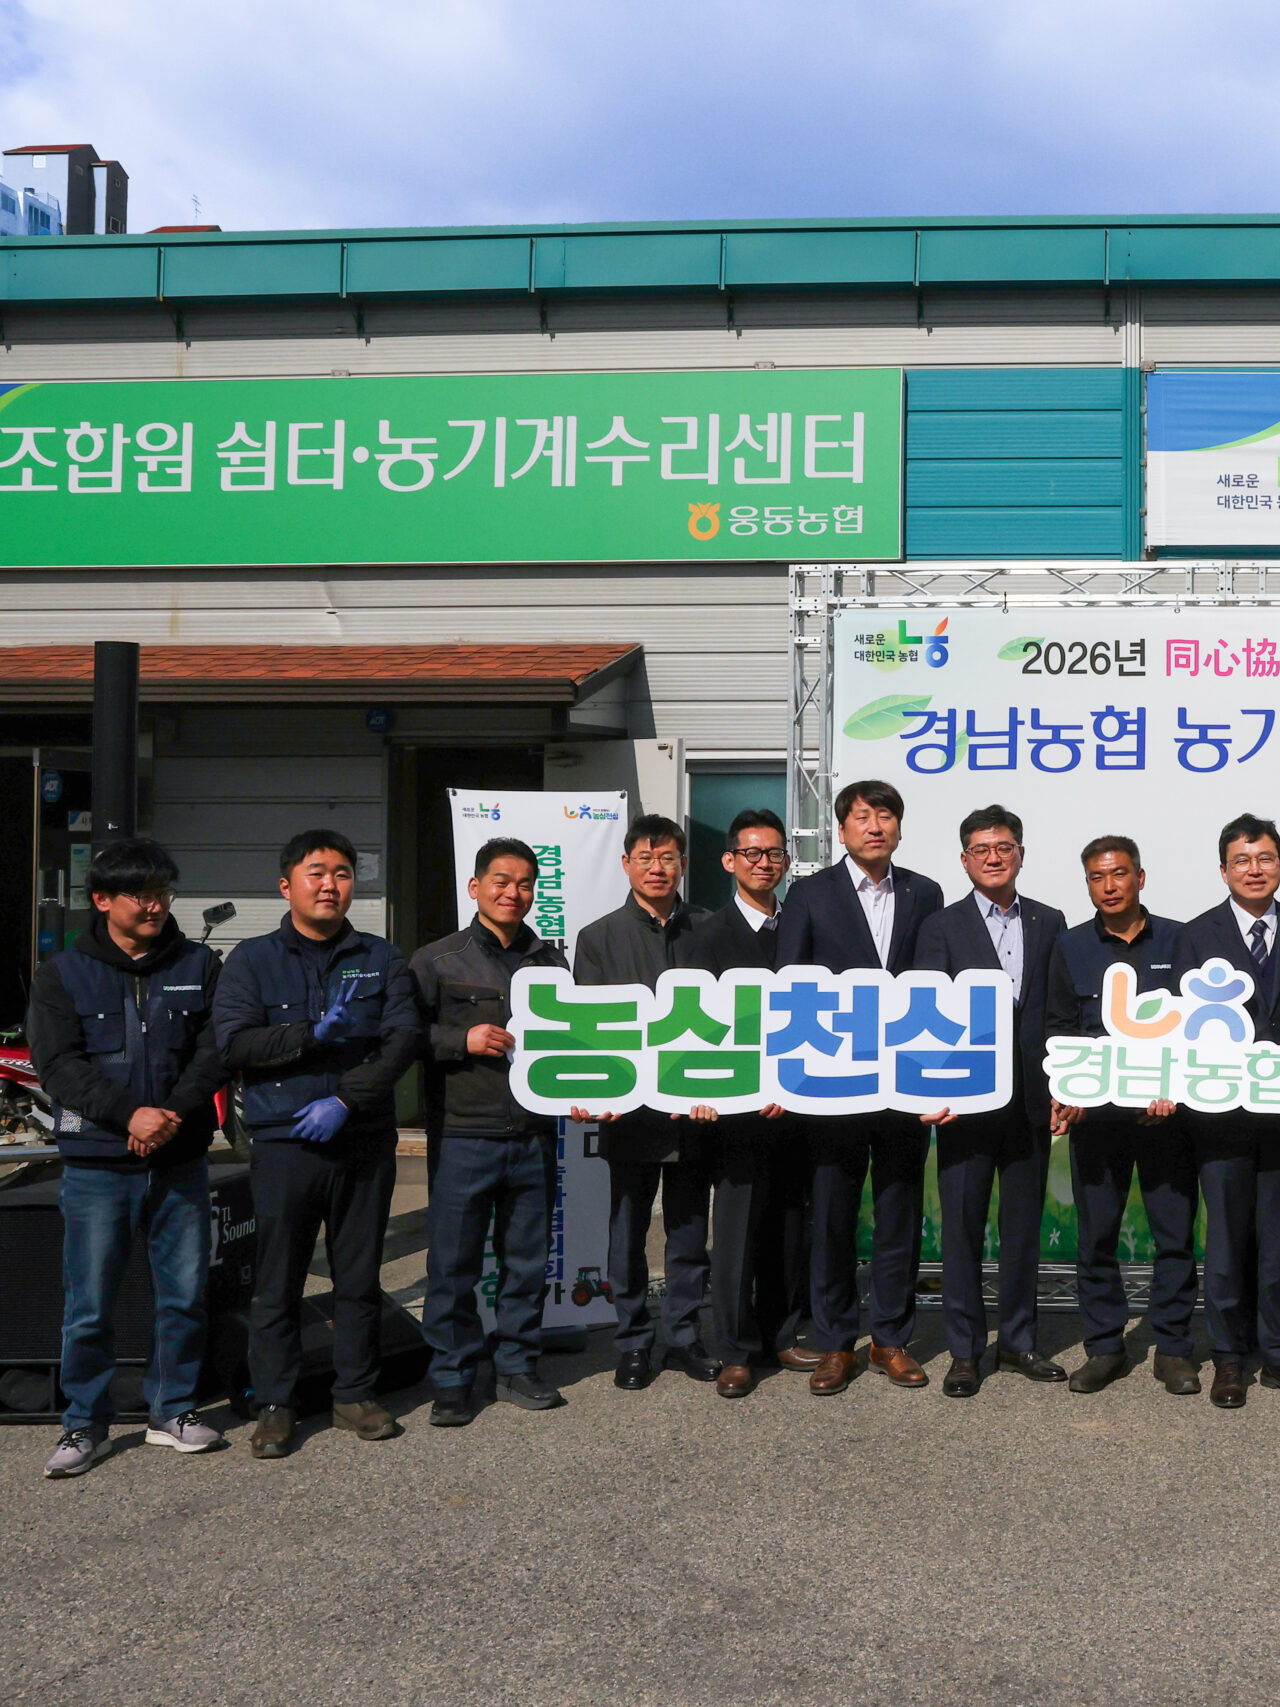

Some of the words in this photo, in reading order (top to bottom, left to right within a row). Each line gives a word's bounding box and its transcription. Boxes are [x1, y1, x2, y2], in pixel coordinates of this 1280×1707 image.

[0, 422, 193, 493] 조합원
[1217, 474, 1259, 488] 새로운
[1217, 495, 1272, 509] 대한민국
[728, 505, 863, 536] 웅동농협
[855, 634, 885, 645] 새로운
[855, 650, 895, 662] 대한민국
[895, 650, 918, 662] 농협
[1022, 639, 1145, 676] 2026년
[900, 705, 1146, 774] 경남농협
[532, 845, 565, 936] 경남농협
[524, 982, 996, 1098] 농심천심
[222, 1216, 255, 1244] Sound
